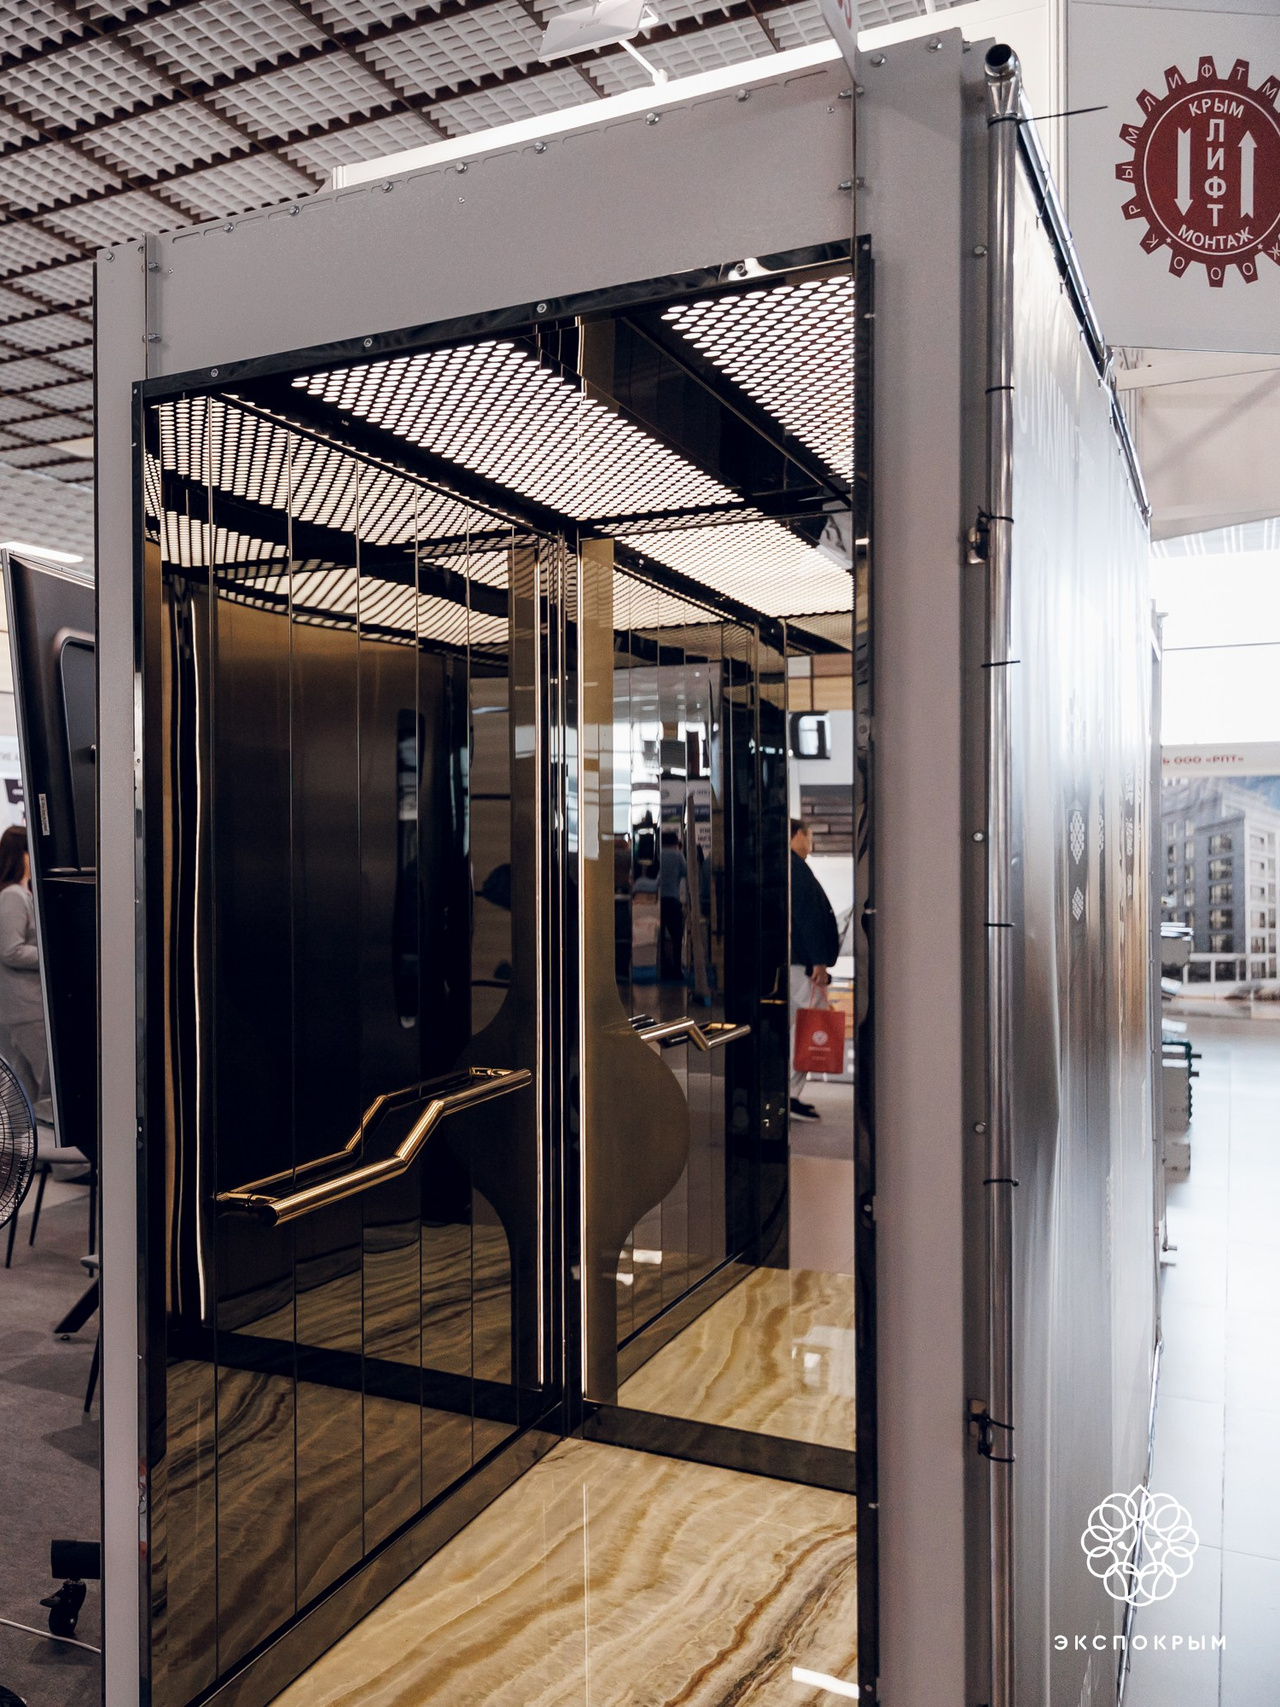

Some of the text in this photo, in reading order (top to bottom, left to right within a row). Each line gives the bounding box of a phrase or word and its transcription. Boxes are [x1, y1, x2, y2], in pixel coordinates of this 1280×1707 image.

[1189, 98, 1245, 119] КРЫМ
[1204, 119, 1227, 227] ЛИФТ
[1178, 224, 1254, 250] МОНТАЖ
